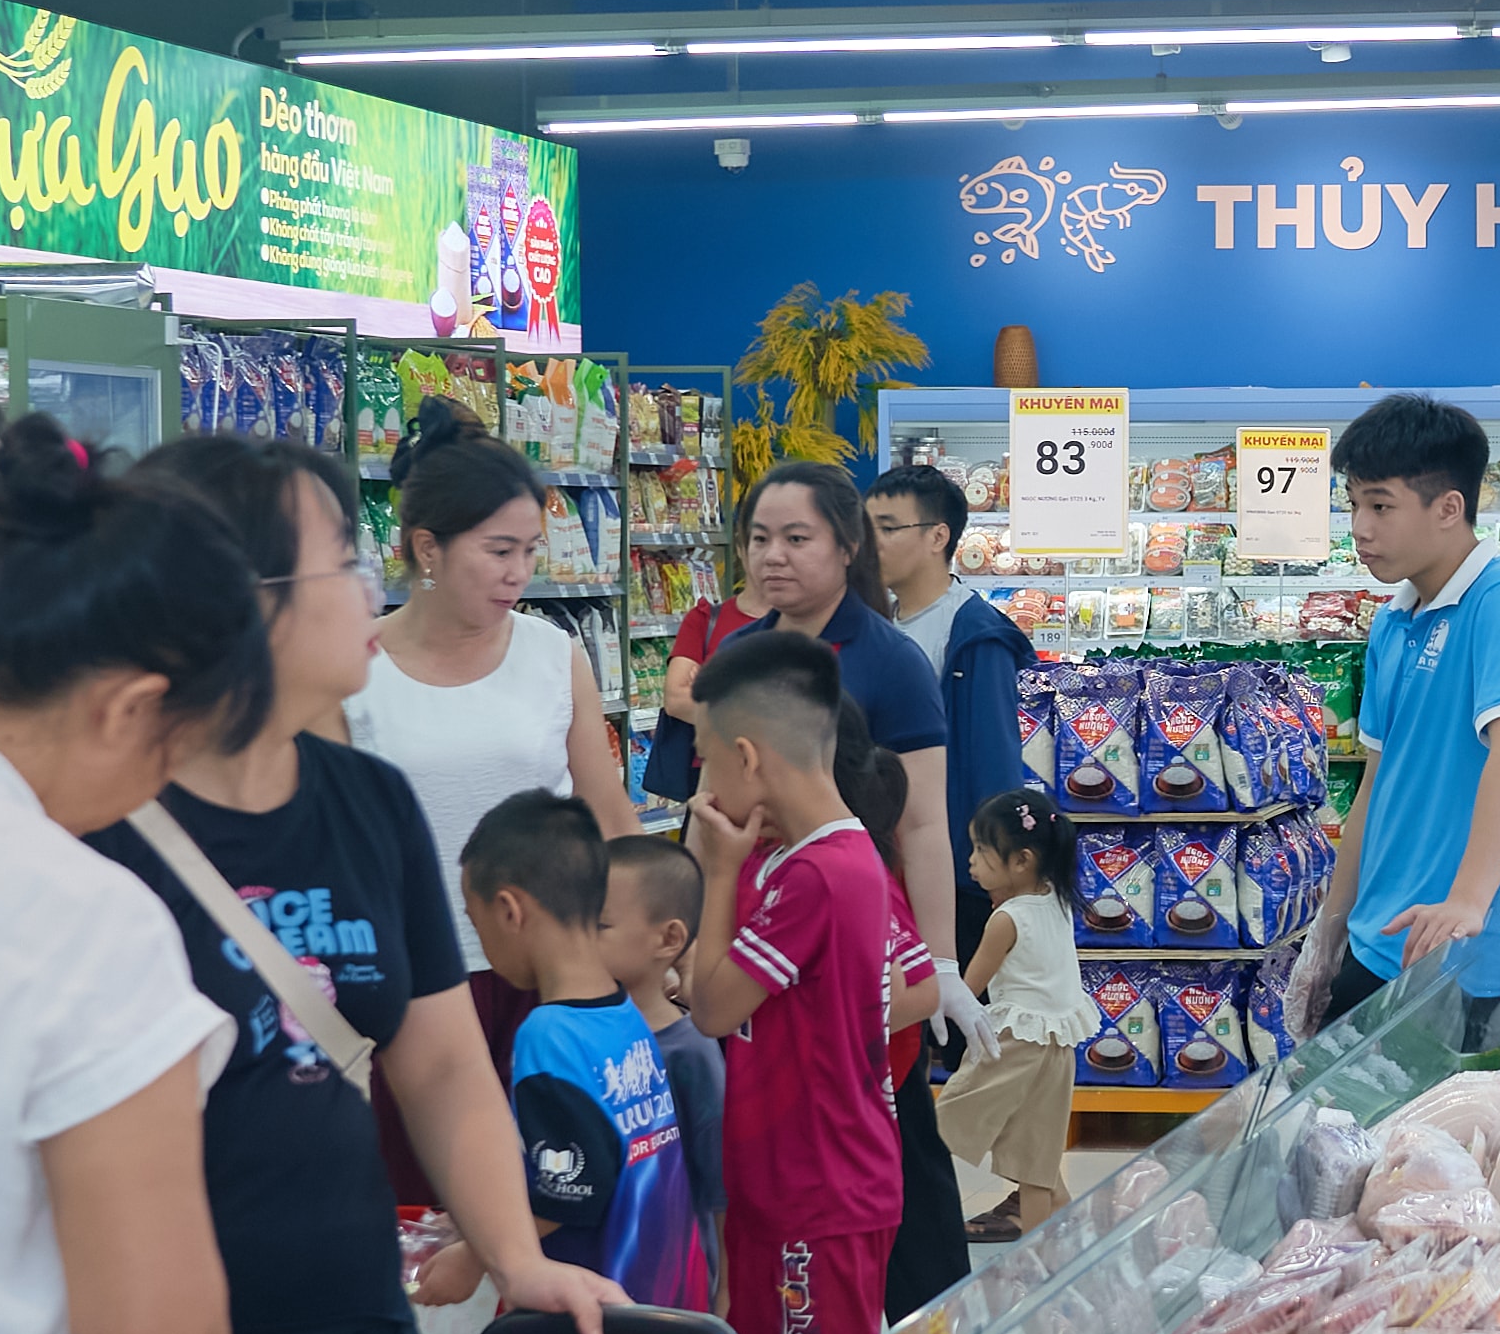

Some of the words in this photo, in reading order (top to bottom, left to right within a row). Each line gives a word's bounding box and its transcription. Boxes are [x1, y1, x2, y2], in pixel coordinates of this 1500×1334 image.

[260, 87, 301, 133] Dẻo
[305, 99, 357, 147] thơm
[260, 143, 298, 188] hàng
[301, 149, 329, 184] đầu
[331, 157, 361, 194] Việt
[362, 173, 394, 196] Nam
[1196, 156, 1450, 252] THỦY
[269, 218, 299, 246] Không
[300, 222, 319, 243] chất
[269, 245, 299, 273] Không
[300, 250, 323, 276] dùng
[533, 266, 551, 284] CAO
[1019, 395, 1085, 410] KHUYẾN
[1090, 397, 1119, 412] MẠI
[1244, 434, 1296, 446] KHUYẾN
[1300, 436, 1323, 449] MẠI
[1035, 439, 1086, 475] 83
[1256, 466, 1296, 494] 97
[1039, 632, 1061, 644] 189
[221, 919, 378, 971] CEAM
